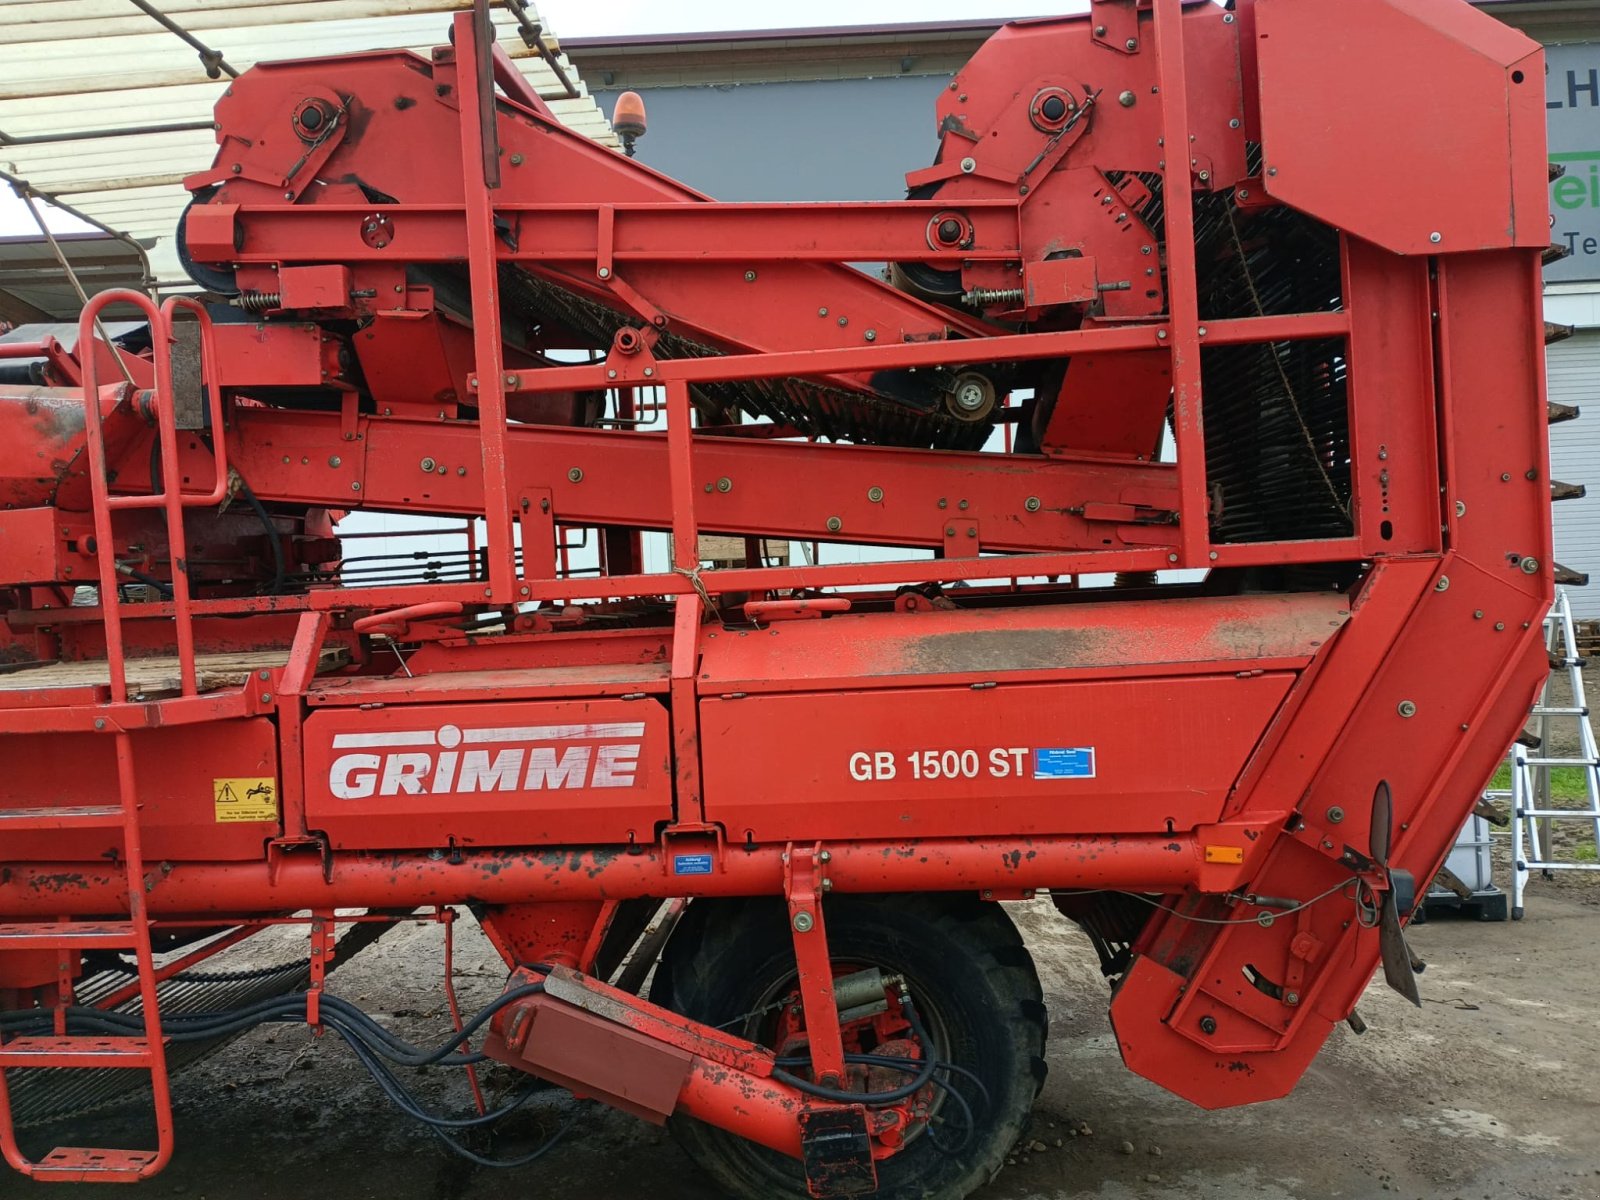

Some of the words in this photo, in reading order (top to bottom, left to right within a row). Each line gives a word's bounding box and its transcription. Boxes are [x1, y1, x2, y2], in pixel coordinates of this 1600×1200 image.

[329, 724, 641, 800] GRIMME
[849, 751, 897, 781] GB
[907, 749, 979, 779] 1500
[988, 747, 1029, 778] ST
